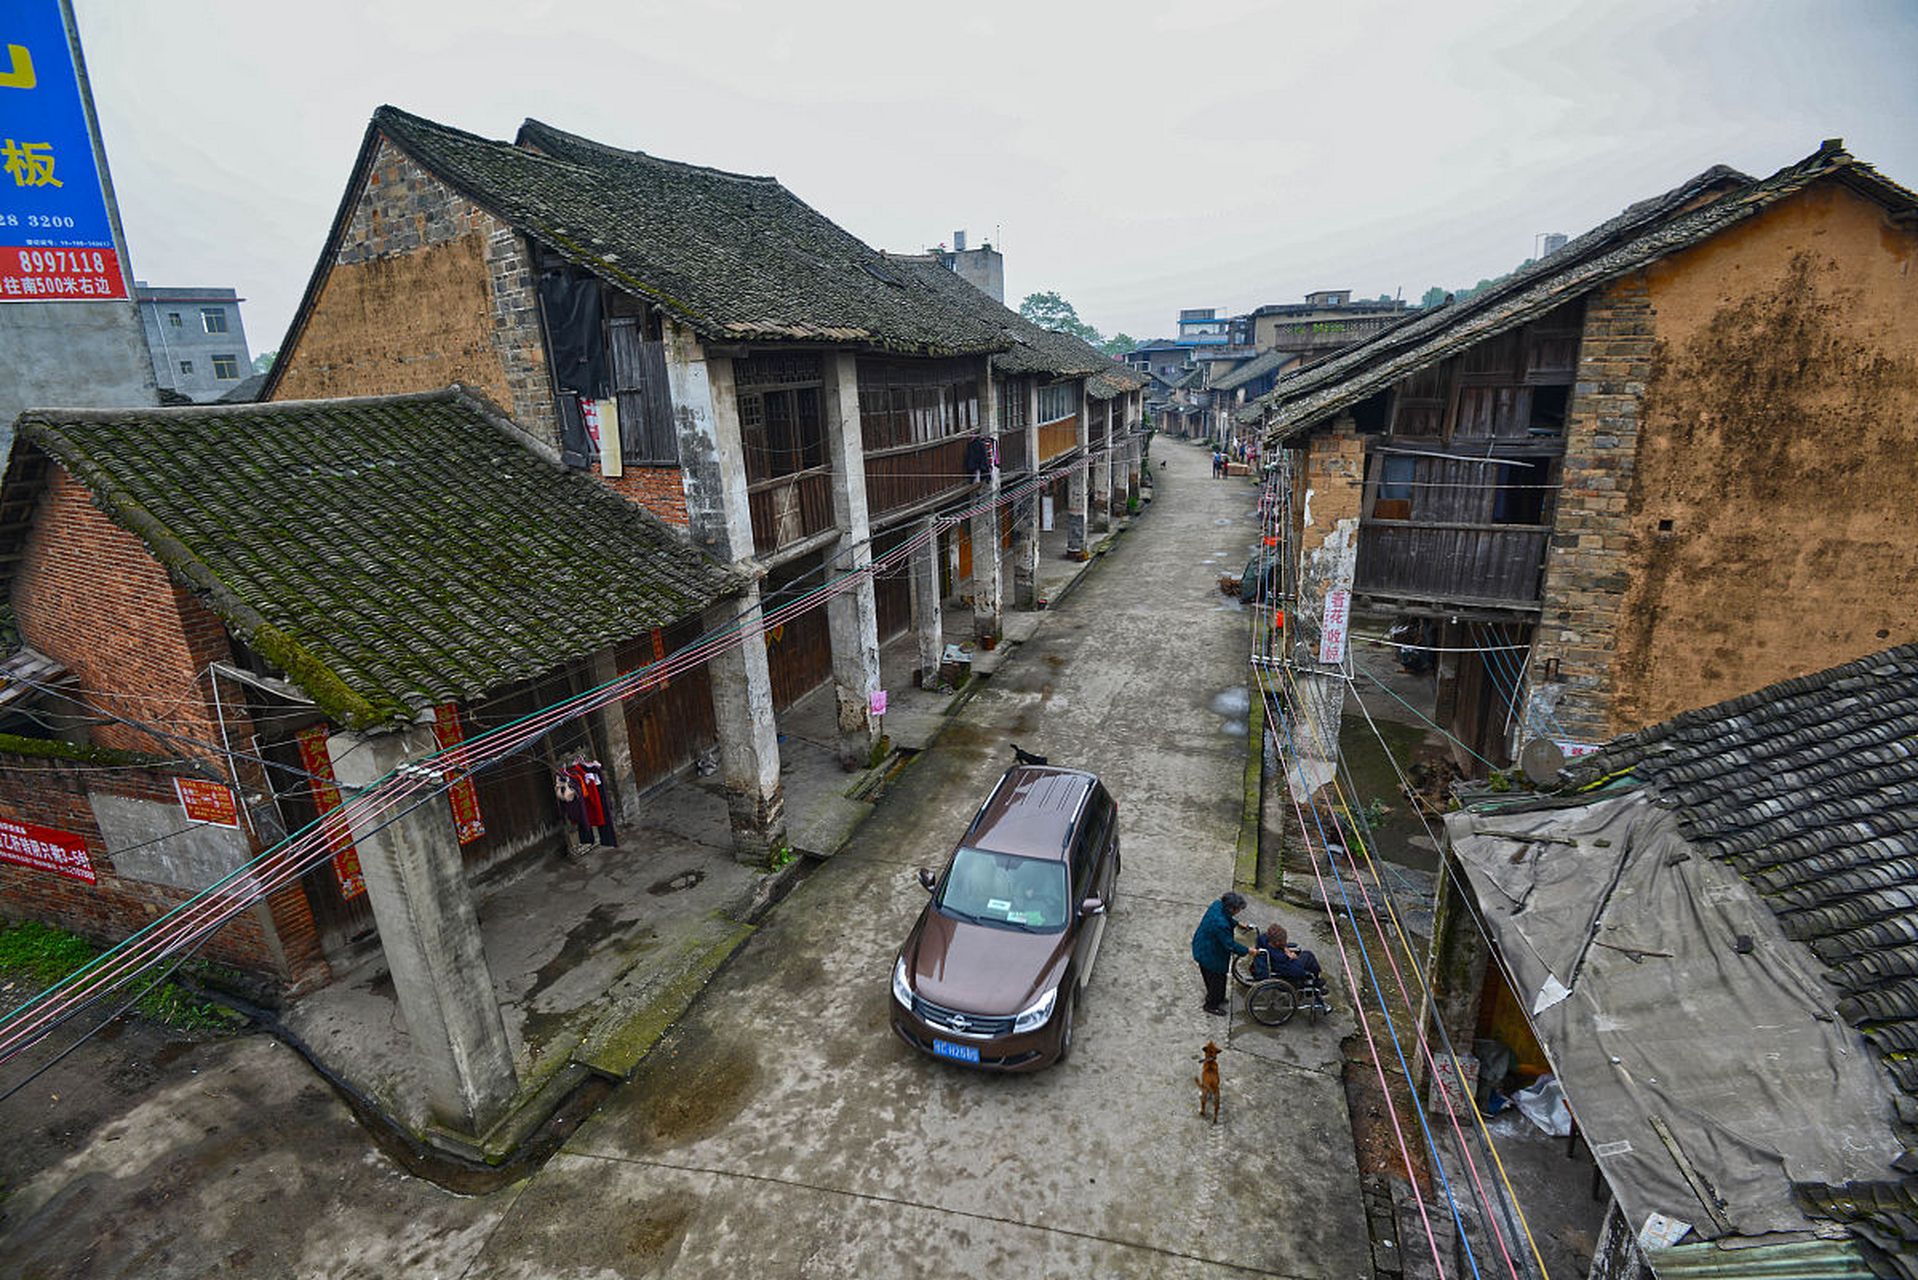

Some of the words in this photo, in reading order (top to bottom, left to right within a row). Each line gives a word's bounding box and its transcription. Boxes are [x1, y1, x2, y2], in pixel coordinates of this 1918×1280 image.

[0, 138, 63, 187] 板
[27, 214, 75, 229] 3200
[18, 250, 105, 274] 8997118
[0, 275, 112, 295] 往南500米右边
[0, 832, 92, 870] 乙肝转阴只需3-5针
